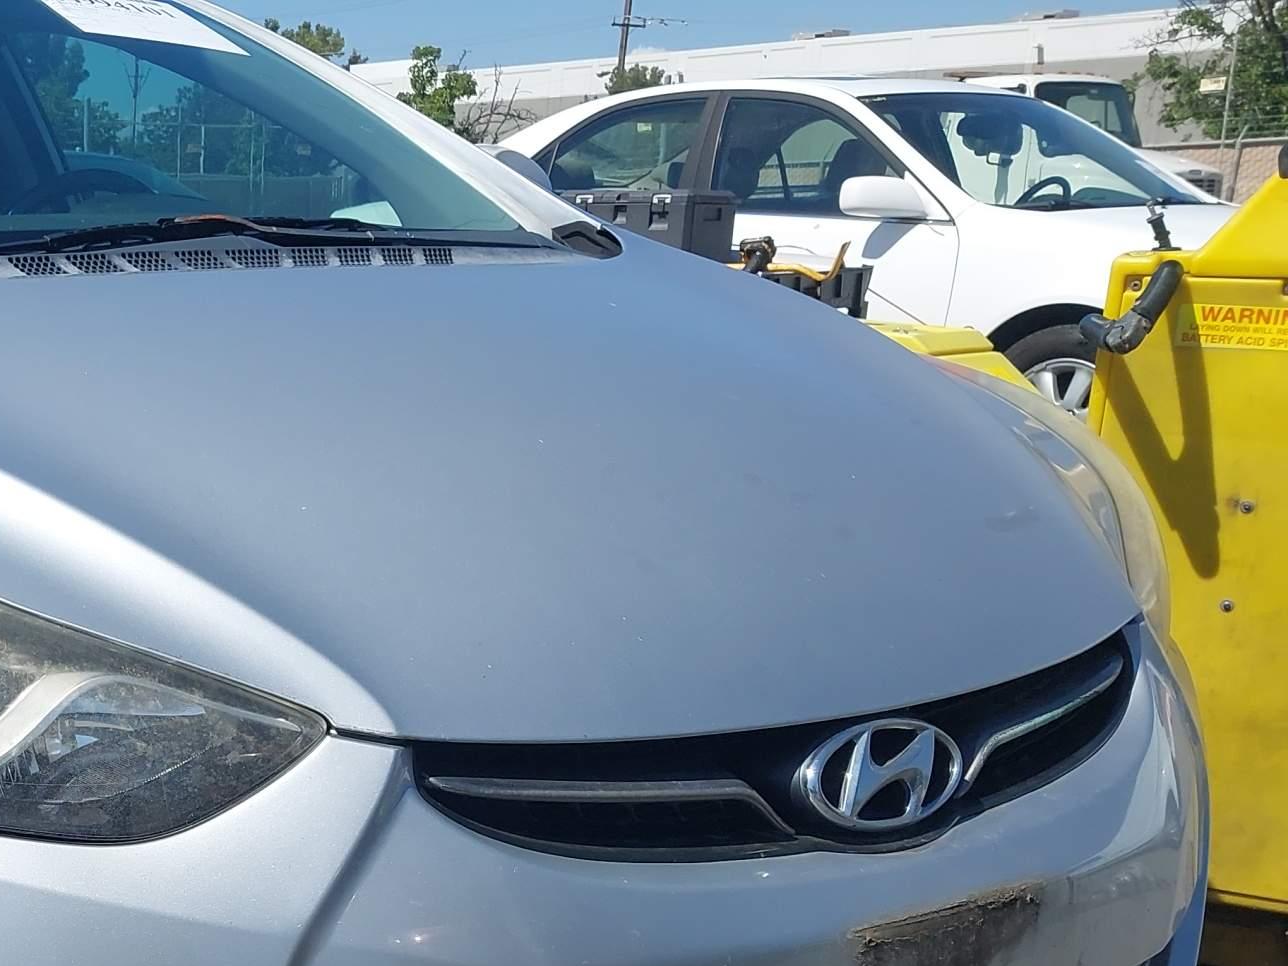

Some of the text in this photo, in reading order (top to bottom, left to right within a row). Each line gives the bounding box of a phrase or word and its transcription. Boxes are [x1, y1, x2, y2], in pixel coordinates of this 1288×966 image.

[1223, 324, 1250, 333] DOWN
[1252, 326, 1273, 335] WILL
[1182, 332, 1234, 345] BATTERY
[1236, 336, 1265, 347] ACID
